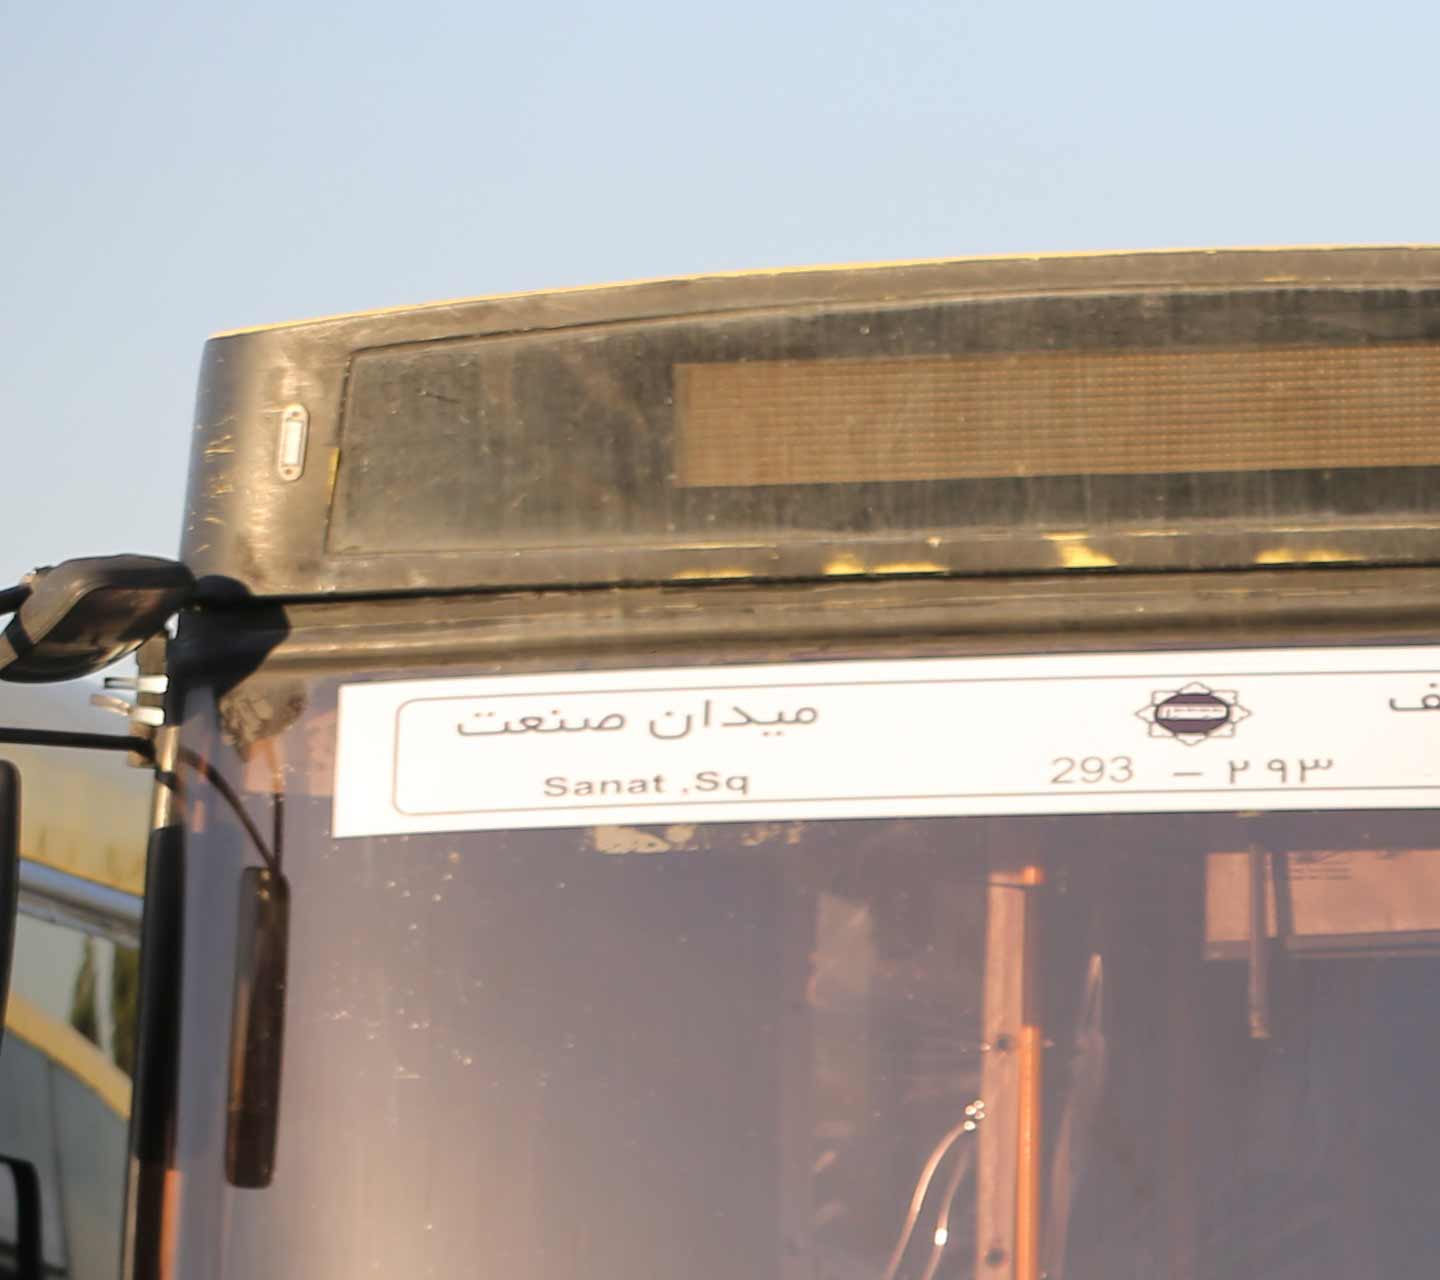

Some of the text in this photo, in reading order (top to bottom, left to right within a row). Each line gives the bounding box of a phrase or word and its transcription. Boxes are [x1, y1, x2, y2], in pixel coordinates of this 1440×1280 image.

[456, 698, 820, 741] میدان صنعت
[543, 771, 667, 797] Sanat
[1050, 756, 1136, 784] 293
[1228, 757, 1334, 785] ۲۹۳
